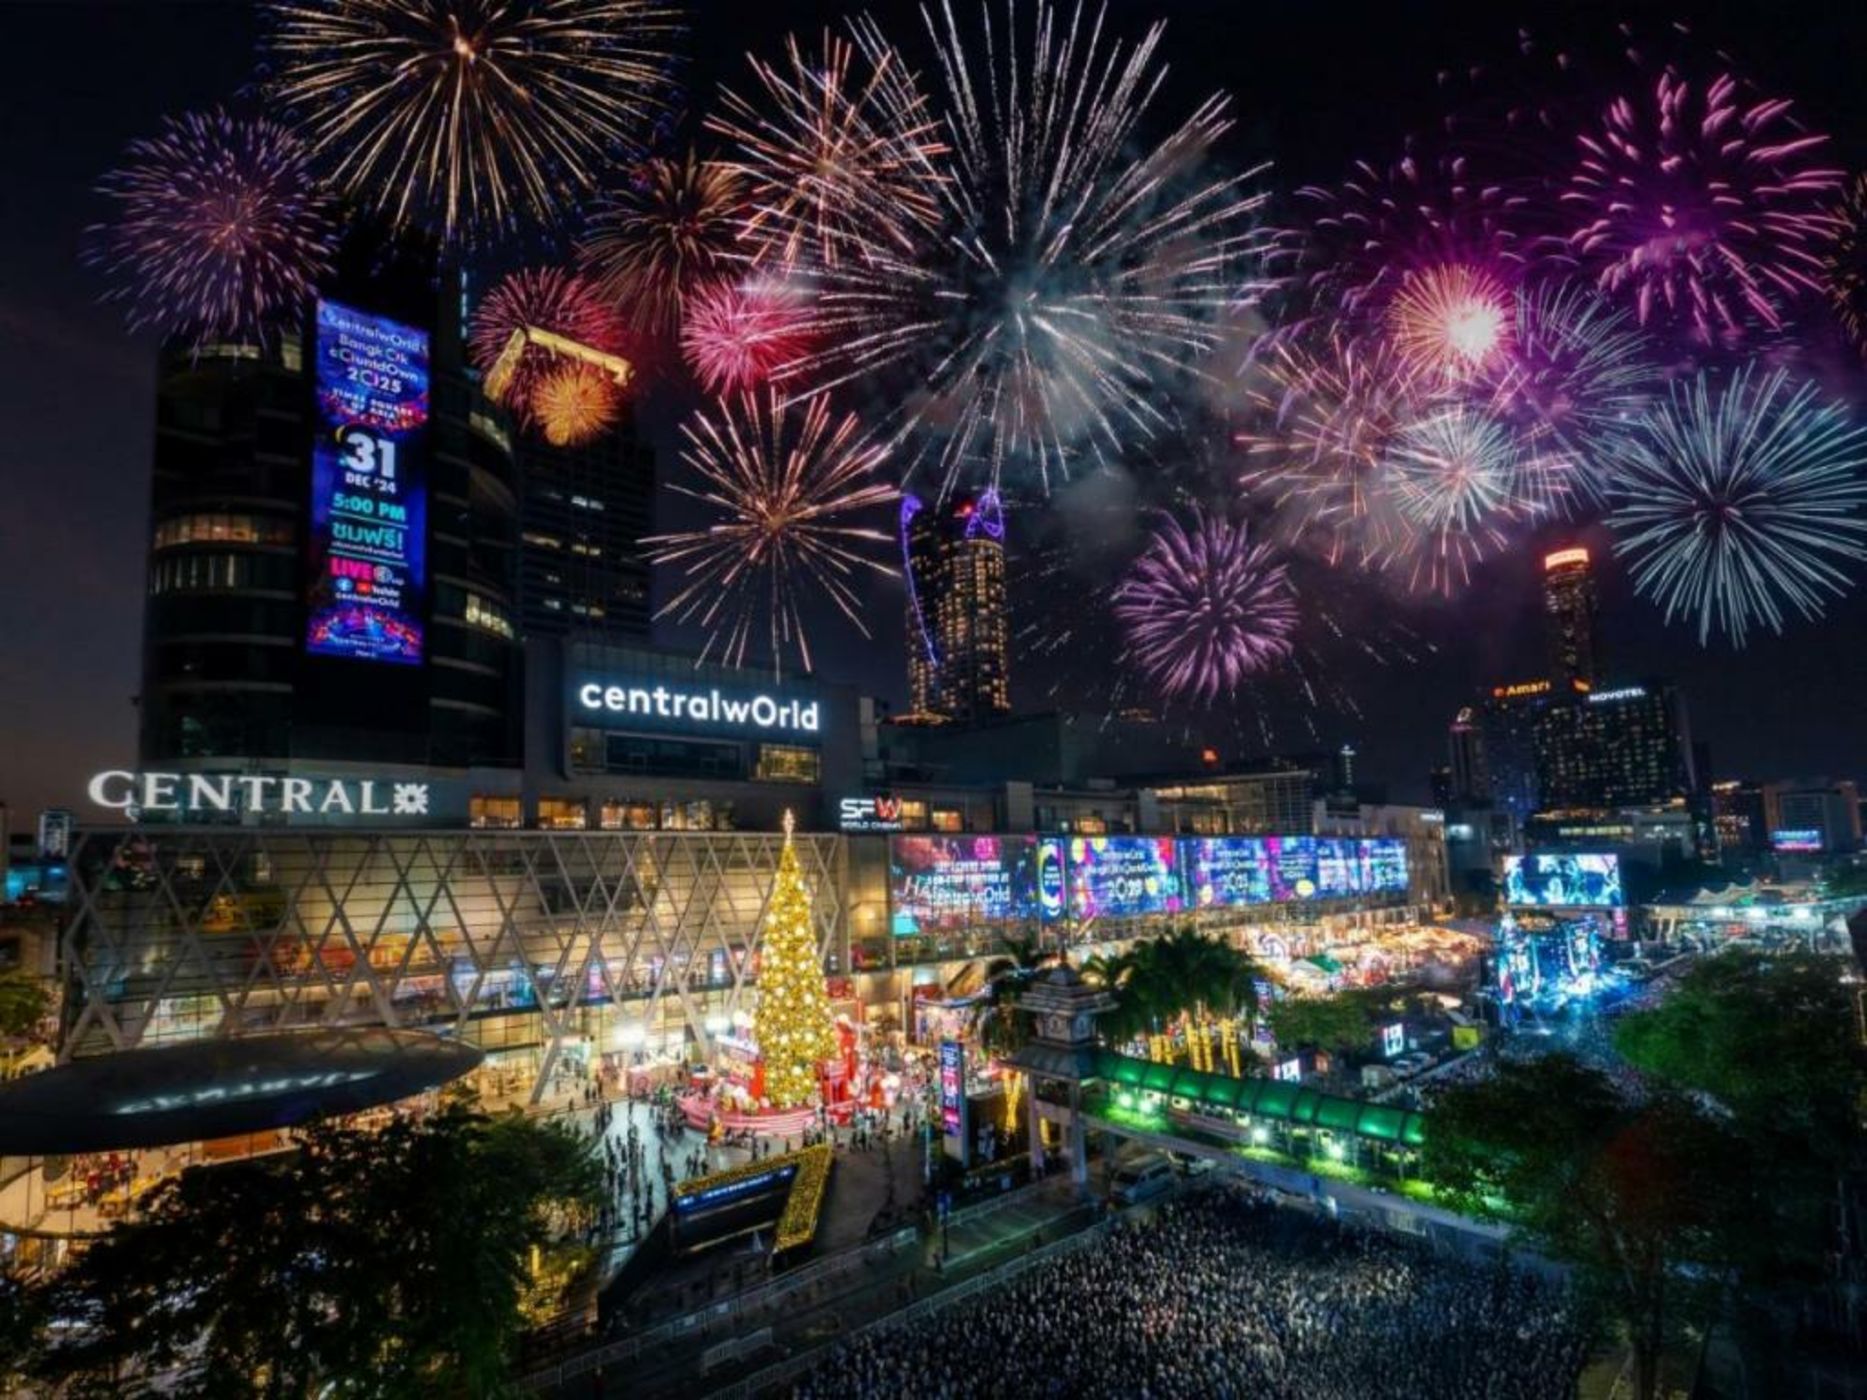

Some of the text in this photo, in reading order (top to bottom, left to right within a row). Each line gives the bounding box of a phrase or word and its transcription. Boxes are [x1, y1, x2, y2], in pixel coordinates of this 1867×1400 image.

[346, 432, 395, 479] 31
[345, 472, 371, 488] DEC
[333, 493, 406, 521] 5:00 PM
[330, 557, 374, 580] LIVE
[1506, 681, 1550, 696] Amari
[1589, 687, 1645, 702] NOVOTEL
[88, 770, 387, 819] CENTRAL
